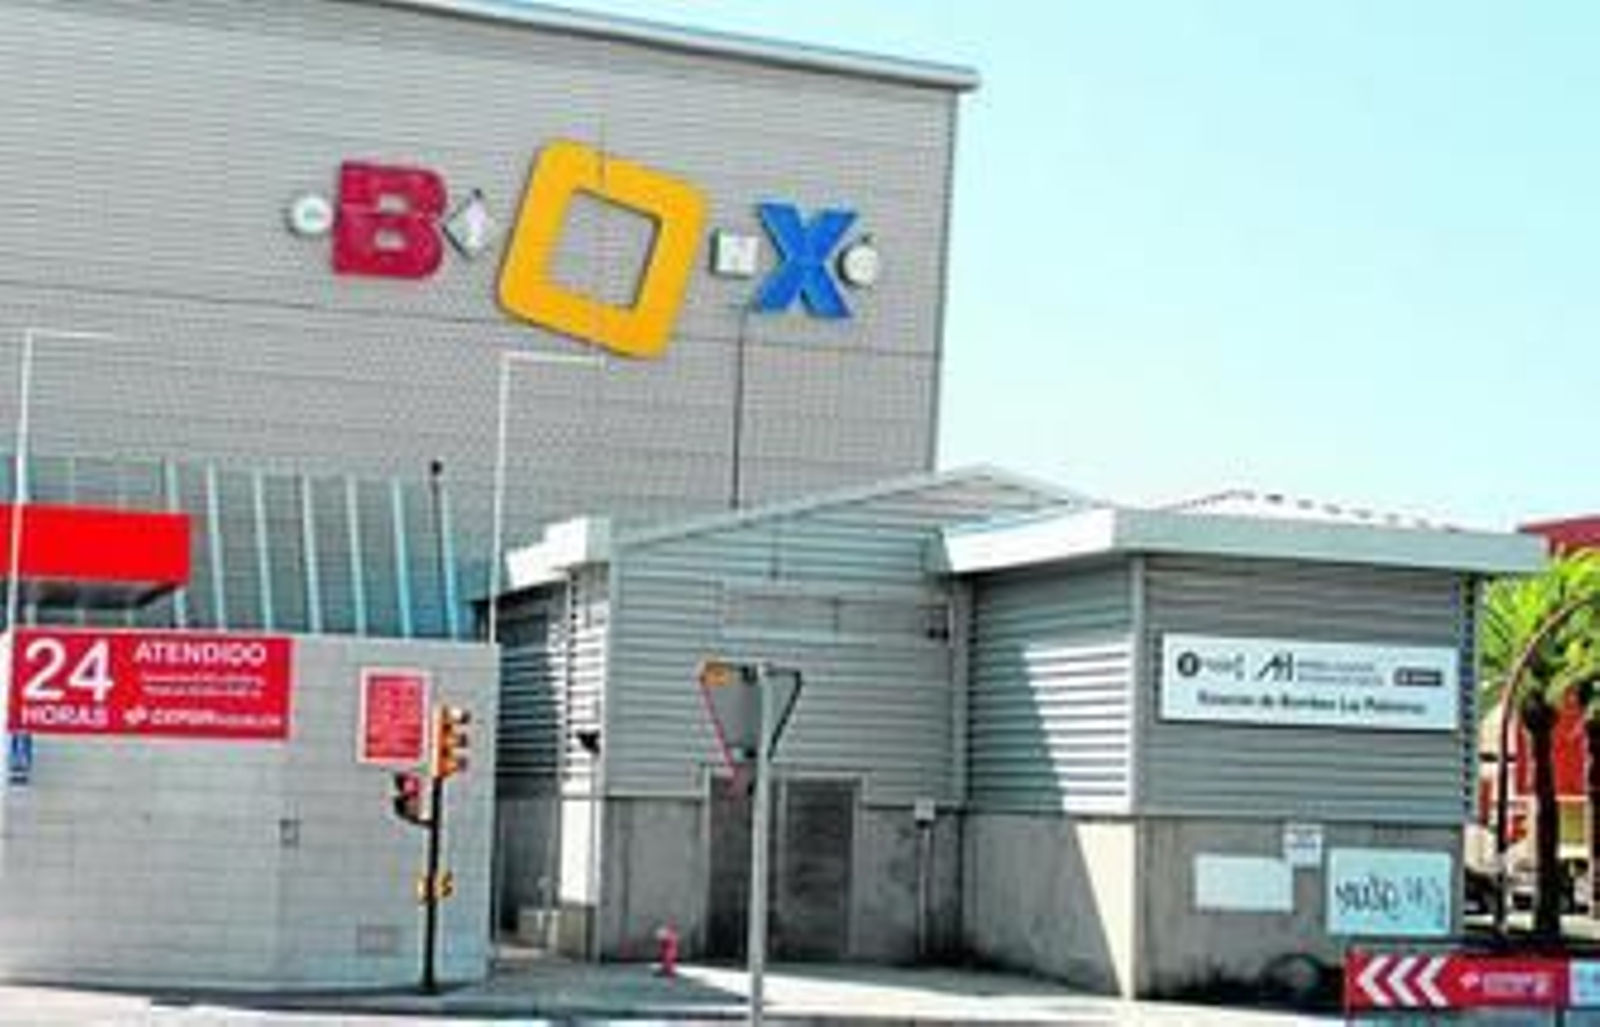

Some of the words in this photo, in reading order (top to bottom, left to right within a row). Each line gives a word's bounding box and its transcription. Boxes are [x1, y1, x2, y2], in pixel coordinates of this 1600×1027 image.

[135, 642, 267, 667] ATENDIDO
[23, 638, 114, 702] 24
[21, 706, 108, 726] HORAS
